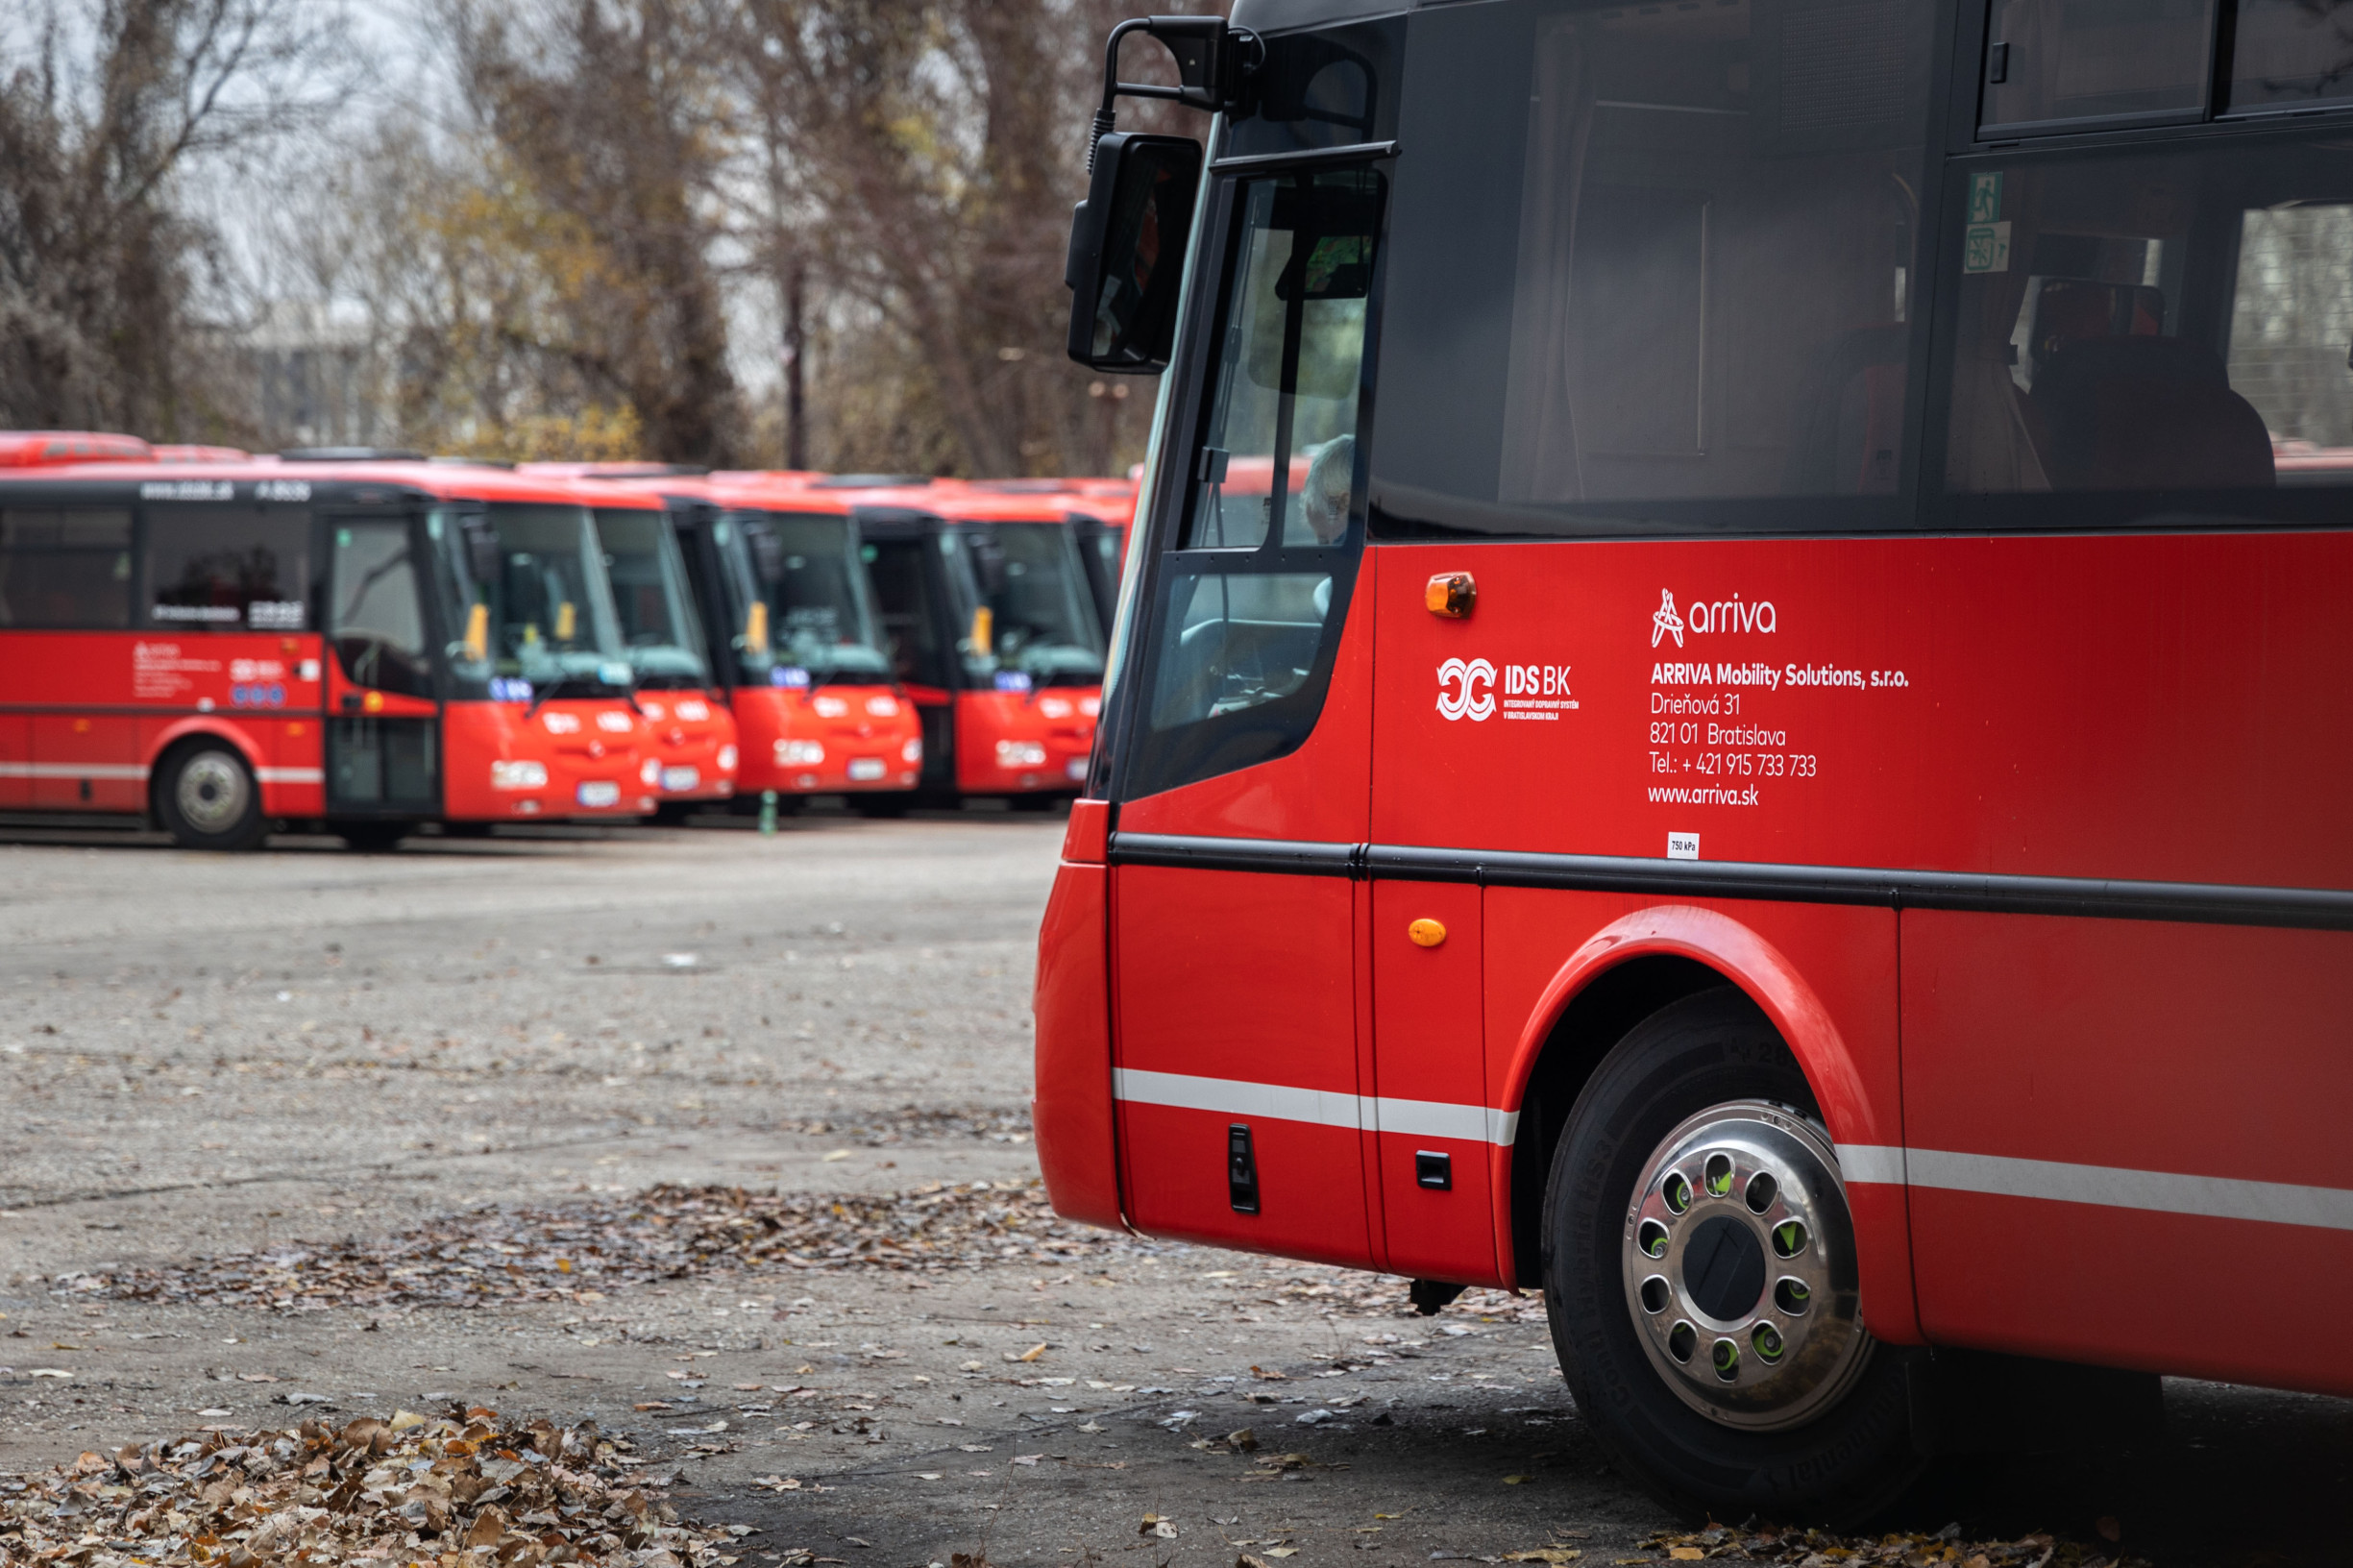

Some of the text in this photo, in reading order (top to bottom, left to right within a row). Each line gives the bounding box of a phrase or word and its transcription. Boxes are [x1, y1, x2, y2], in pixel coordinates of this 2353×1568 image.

[1689, 592, 1777, 633] arriva
[1505, 665, 1572, 695] IDS BK
[1651, 663, 1909, 691] ARRIVA Mobility Solutions, s.r.o.
[1560, 699, 1580, 709] SYSTÉM
[1652, 693, 1740, 715] Drieňová 31
[1504, 711, 1508, 720] V
[1650, 723, 1786, 746] 821 01 Bratislava
[1650, 751, 1678, 772] Tel.:
[1696, 753, 1722, 774] 421
[1727, 753, 1752, 775] 915
[1757, 754, 1784, 776] 733
[1790, 755, 1817, 776] 733
[1648, 784, 1759, 805] www.arriva.sk
[1672, 841, 1695, 851] 750 kPa
